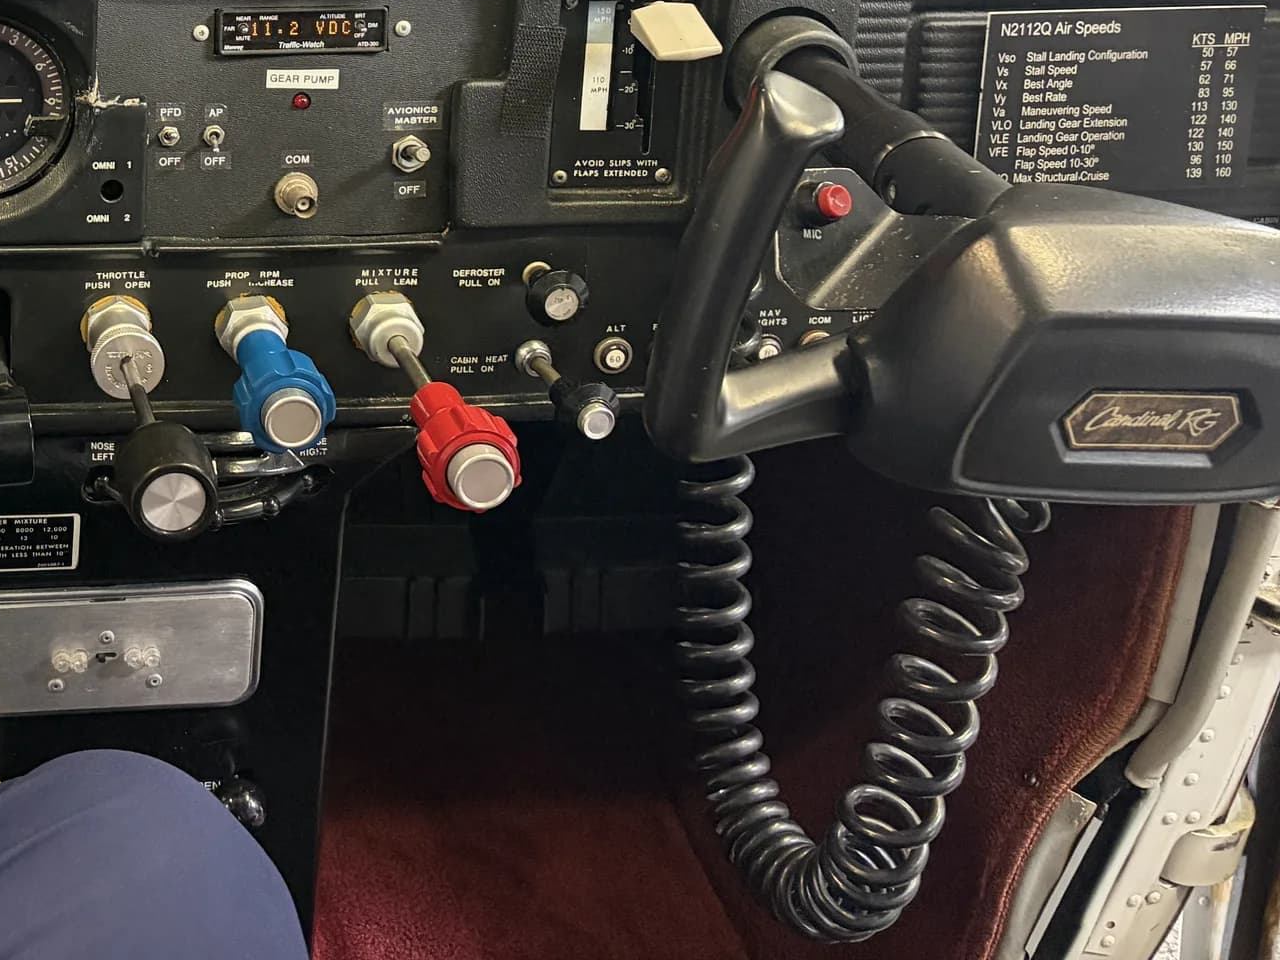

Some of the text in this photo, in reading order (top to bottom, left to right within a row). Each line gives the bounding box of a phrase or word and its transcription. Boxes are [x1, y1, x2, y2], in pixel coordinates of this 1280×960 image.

[1000, 20, 1122, 38] N2112Q Air Speeds
[1192, 32, 1250, 46] KTS MPH
[278, 40, 325, 49] Traffic-Watch
[1026, 48, 1148, 64] Stall Landing Configuration
[270, 74, 335, 84] GEAR PUMP
[1024, 78, 1072, 91] Best Angle
[388, 106, 438, 115] AVIONICS
[1021, 104, 1112, 118] Maneuvering Speed
[395, 116, 437, 124] MASTER
[1020, 116, 1127, 131] Landing Gear Extension
[285, 155, 310, 164] COM
[575, 159, 658, 167] AVOID SLIPS WITH
[92, 162, 115, 170] OMNI
[574, 169, 648, 177] FLAPS EXTENDED
[803, 229, 822, 240] MIC
[96, 271, 146, 280] THROTTLE
[361, 269, 418, 277] MIXTURE
[453, 268, 505, 277] DEFROSTER
[85, 280, 151, 290] PUSH OPEN
[459, 279, 501, 287] PULL ON
[1084, 407, 1221, 437] Cardinal RG
[90, 442, 115, 451] NOSE
[91, 452, 115, 461] LEFT
